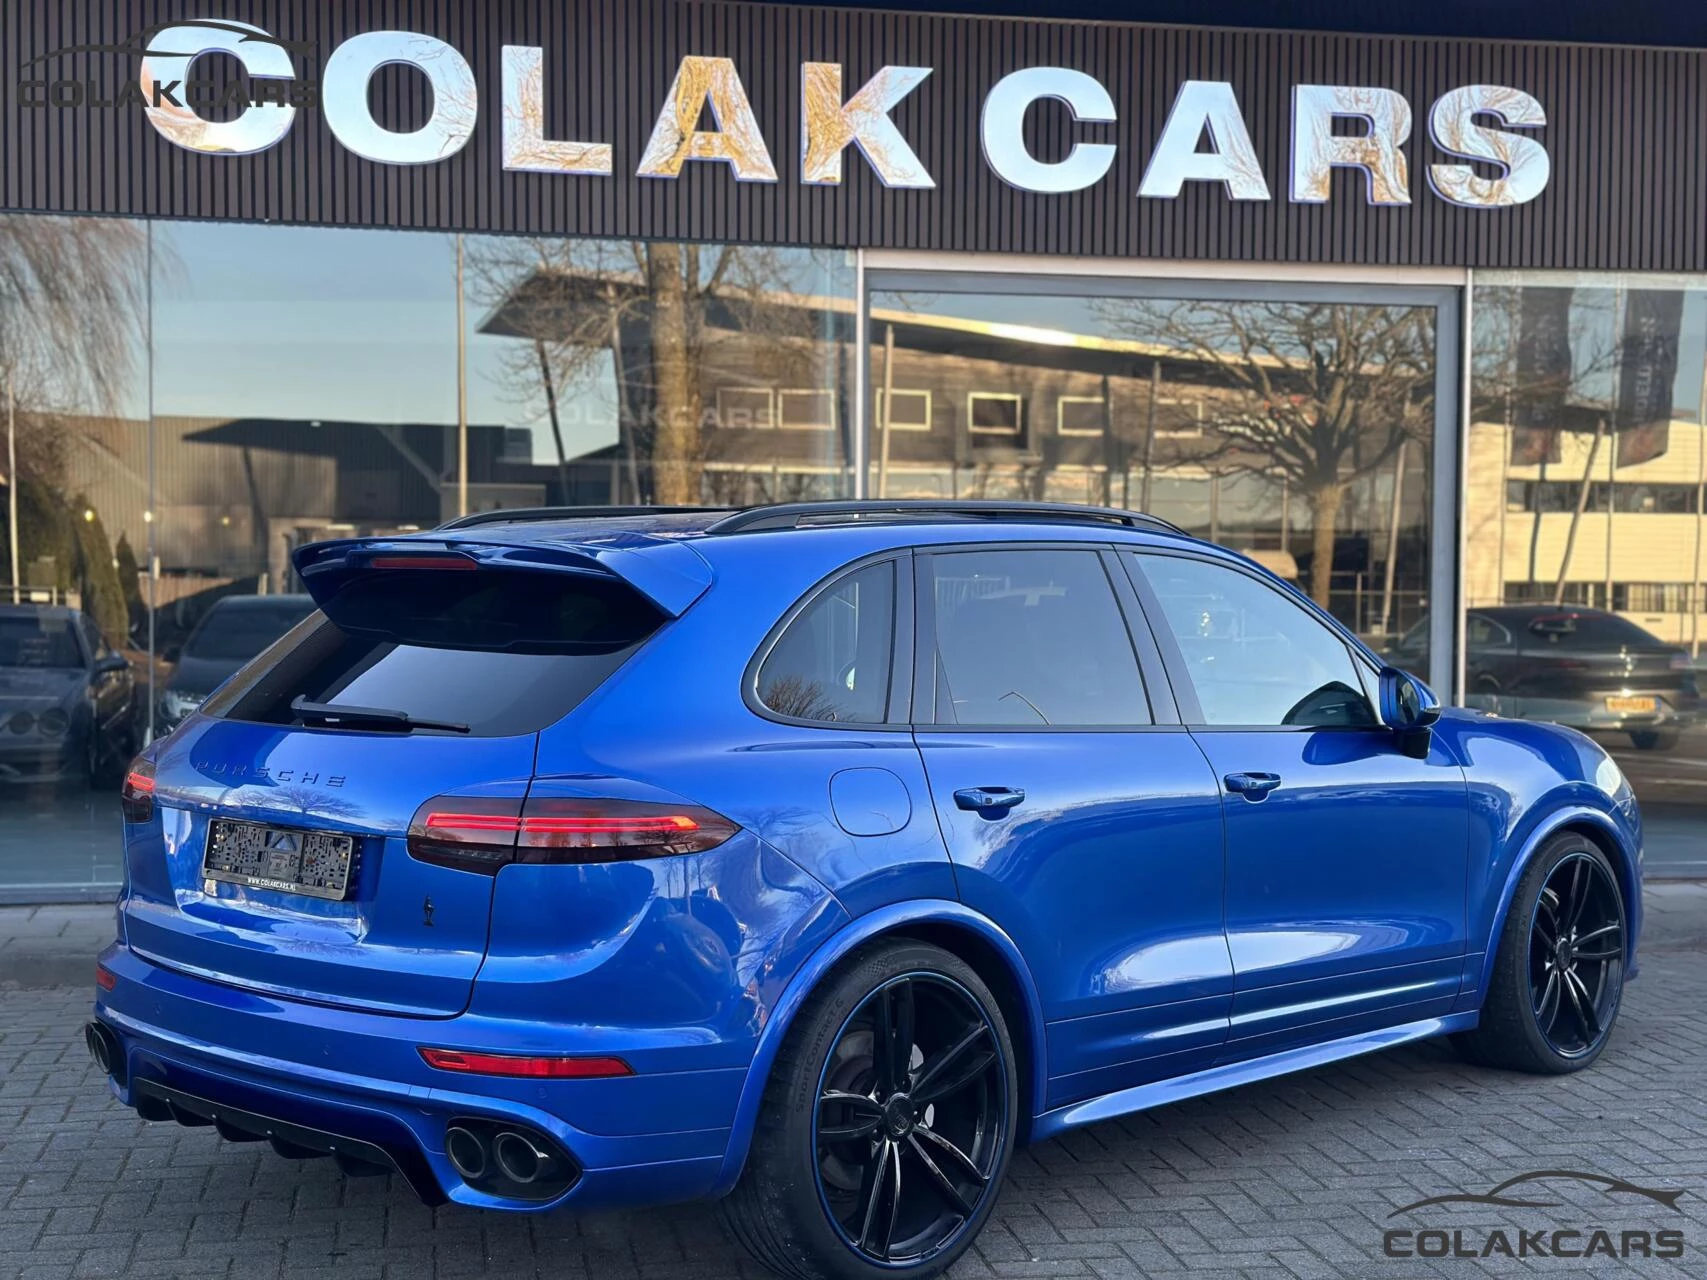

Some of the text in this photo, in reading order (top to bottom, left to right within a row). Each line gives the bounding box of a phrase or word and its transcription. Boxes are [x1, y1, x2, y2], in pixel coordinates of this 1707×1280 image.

[140, 18, 1550, 207] COLAK CARS
[195, 758, 347, 788] PORSCHE
[247, 876, 297, 891] WWW.COLAKCARS.NL
